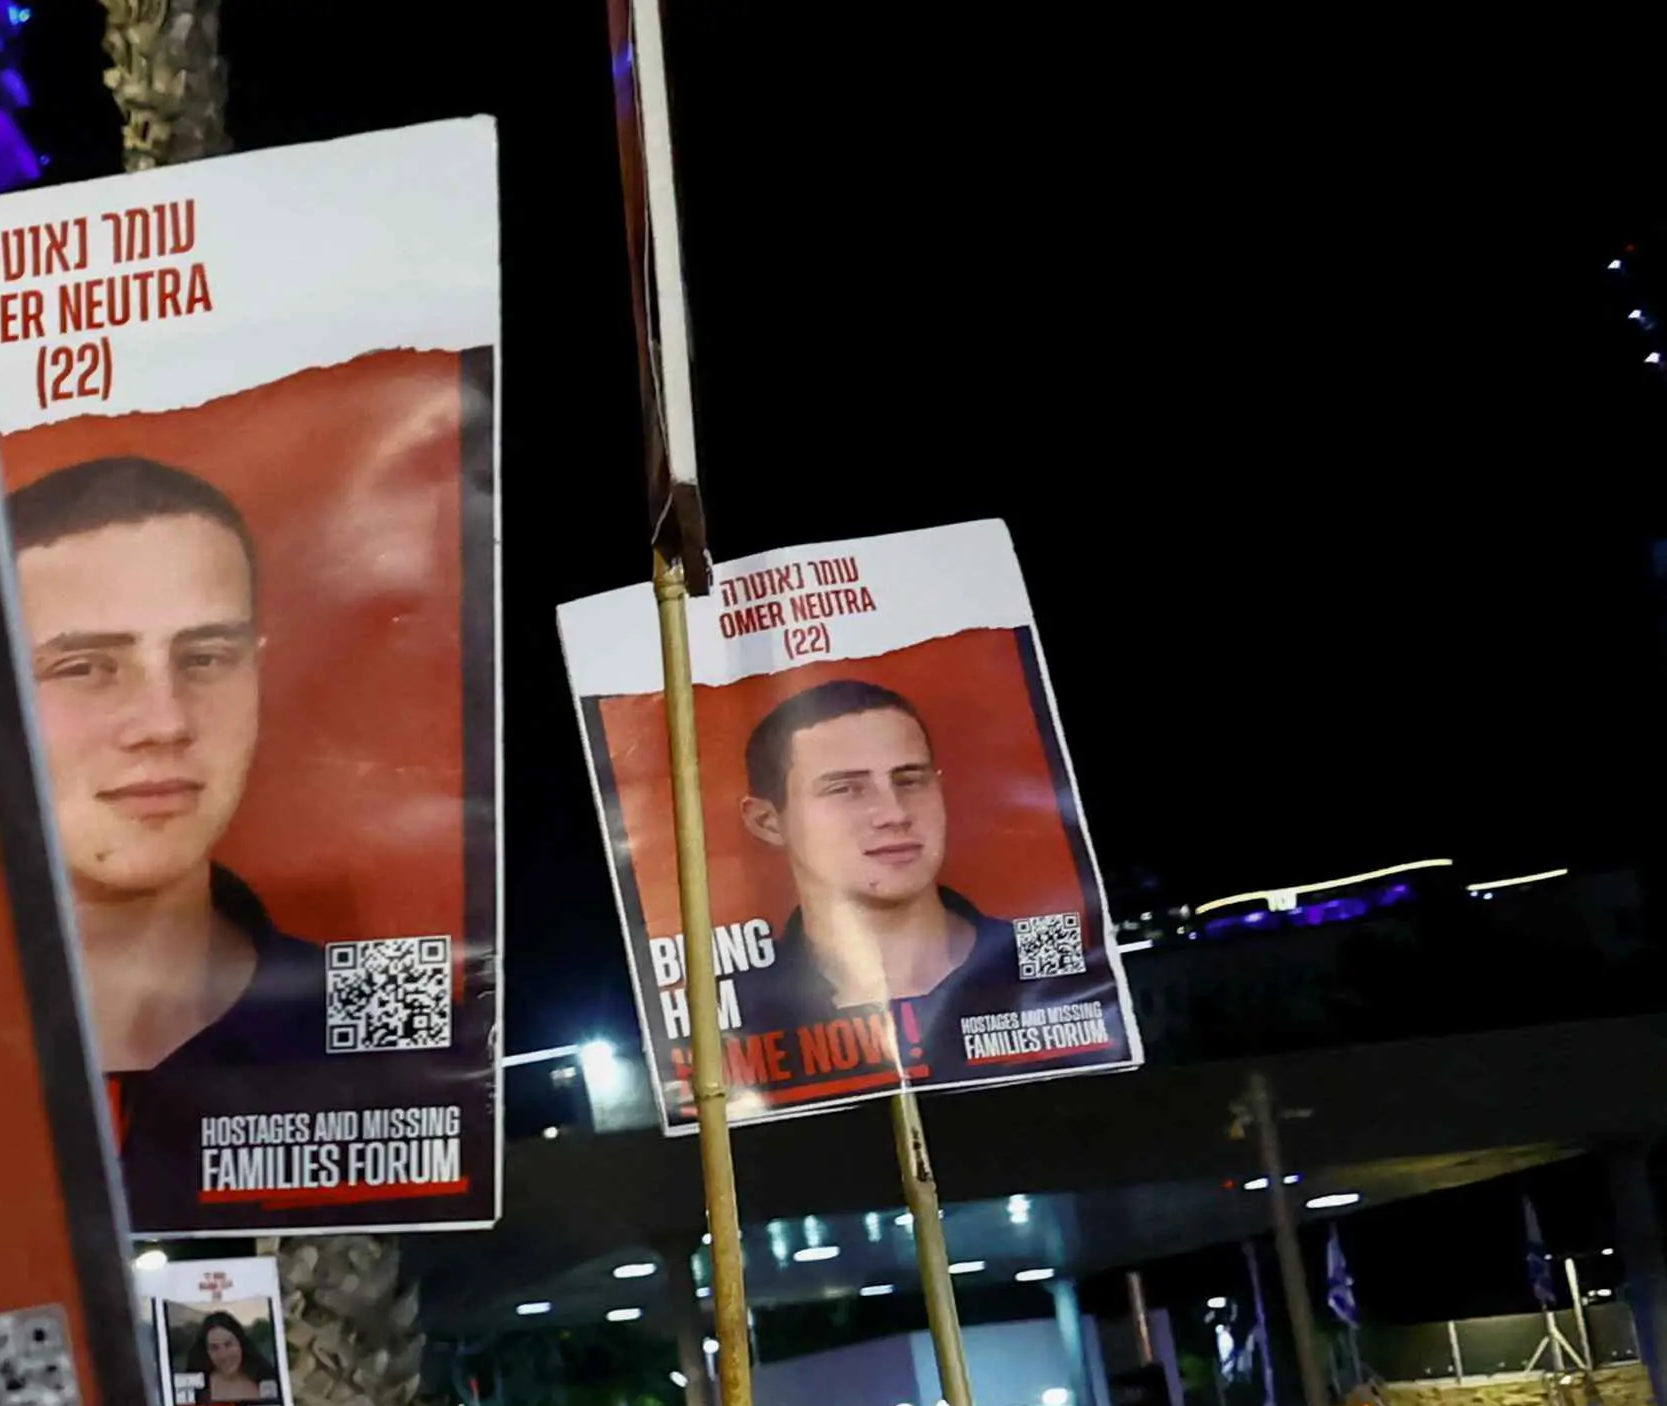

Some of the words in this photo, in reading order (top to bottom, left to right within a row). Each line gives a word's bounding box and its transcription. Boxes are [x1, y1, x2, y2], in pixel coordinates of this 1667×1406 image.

[100, 198, 196, 264] עומר
[58, 263, 213, 334] NEUTRA
[36, 336, 112, 409] (22)
[720, 562, 805, 607] נאוטרה
[807, 556, 859, 587] עומר
[719, 601, 786, 639] OMER
[790, 586, 877, 622] NEUTRA
[783, 622, 830, 660] (22)
[659, 979, 742, 1040] HM
[961, 1011, 1019, 1034] HOSTAGES
[1020, 1008, 1047, 1028] AND
[1046, 1001, 1102, 1024] MISSING
[798, 1001, 923, 1077] NOW!
[964, 1027, 1041, 1060] FAMILIES
[1045, 1019, 1109, 1050] FORUM
[201, 1112, 310, 1146] HOSTAGES
[314, 1110, 356, 1142] AND
[362, 1106, 460, 1140] MISSING
[202, 1144, 340, 1192] FAMILIES
[348, 1138, 460, 1187] FORUM
